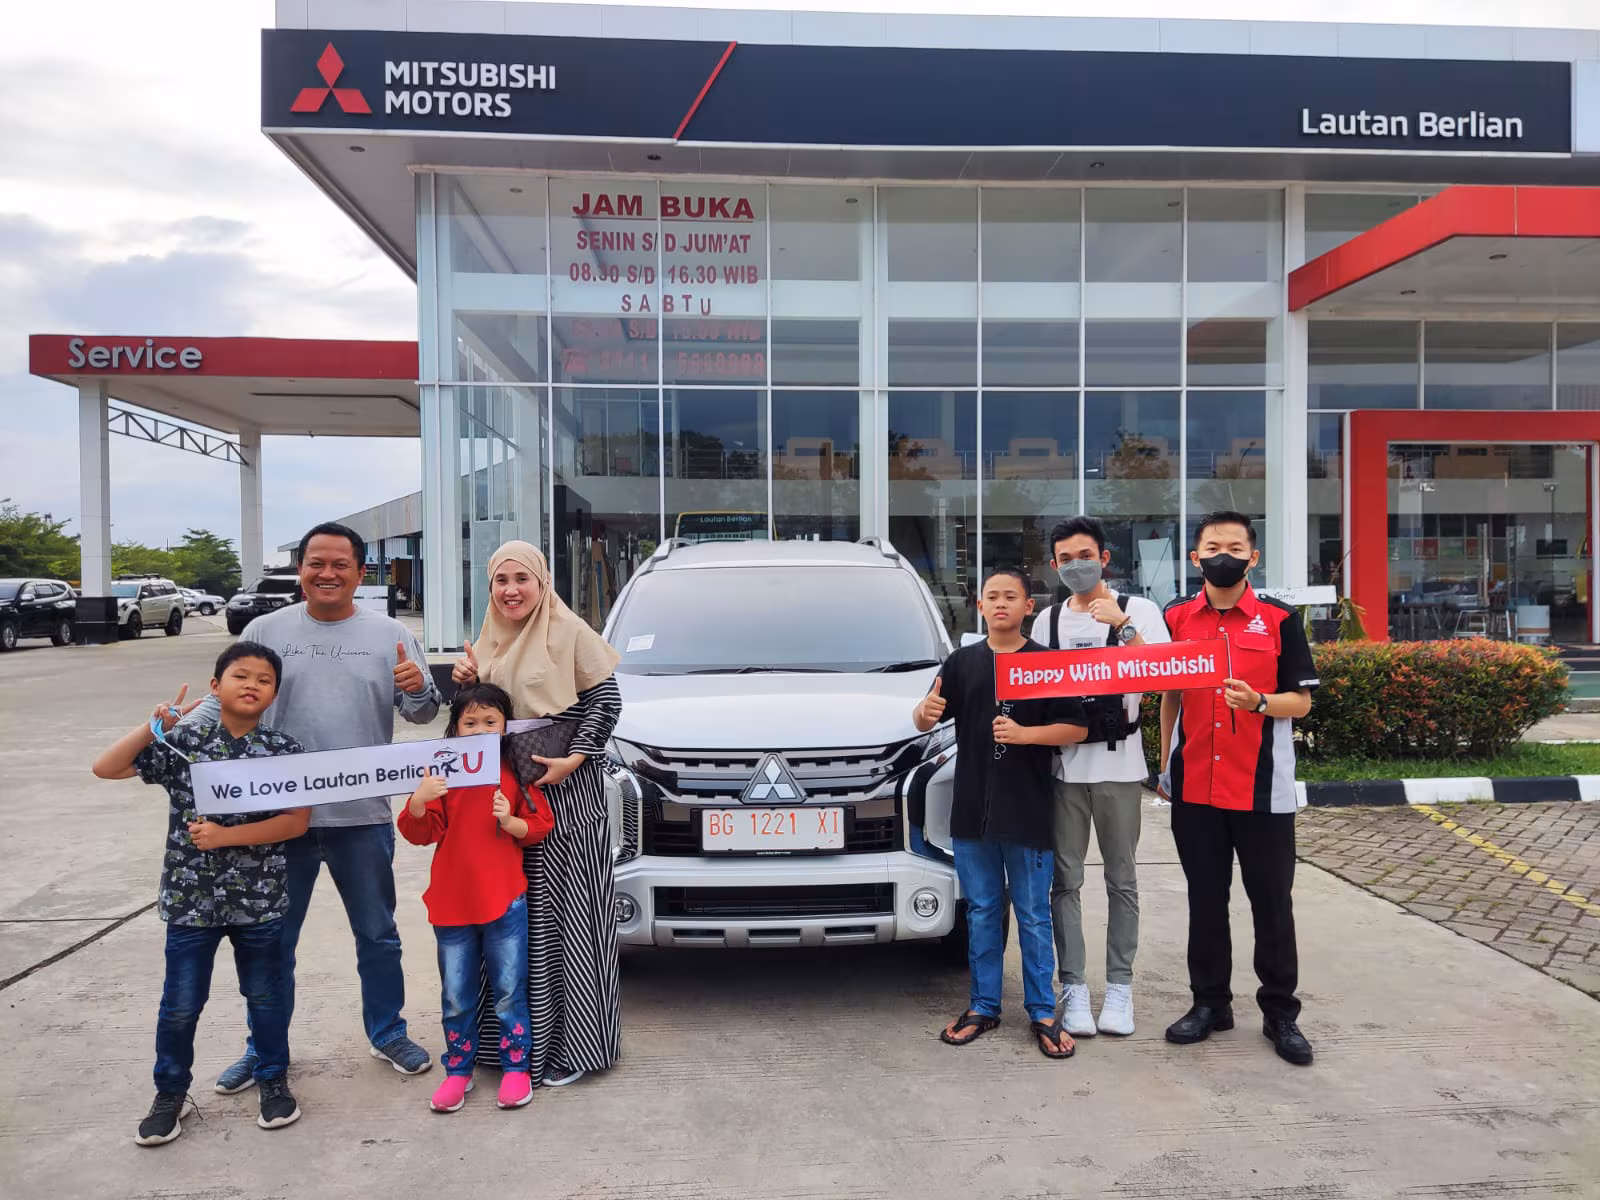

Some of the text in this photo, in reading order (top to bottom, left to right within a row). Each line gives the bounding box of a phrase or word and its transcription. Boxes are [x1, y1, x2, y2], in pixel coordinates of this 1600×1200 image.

[384, 60, 557, 90] MITSUBISHI
[384, 91, 512, 118] MOTORS
[1302, 108, 1524, 138] Lautan Berlian
[572, 193, 755, 219] JAM BUKA
[576, 230, 636, 252] SENIN
[626, 264, 656, 285] S/D
[668, 265, 717, 285] 16.30
[723, 265, 759, 285] WIB
[68, 337, 203, 369] Service
[1009, 654, 1215, 686] Happy With Mitsubishi
[211, 783, 243, 799] We
[250, 780, 298, 796] Love
[304, 772, 370, 791] Lautan
[709, 812, 734, 836] BG
[750, 811, 798, 836] 1221
